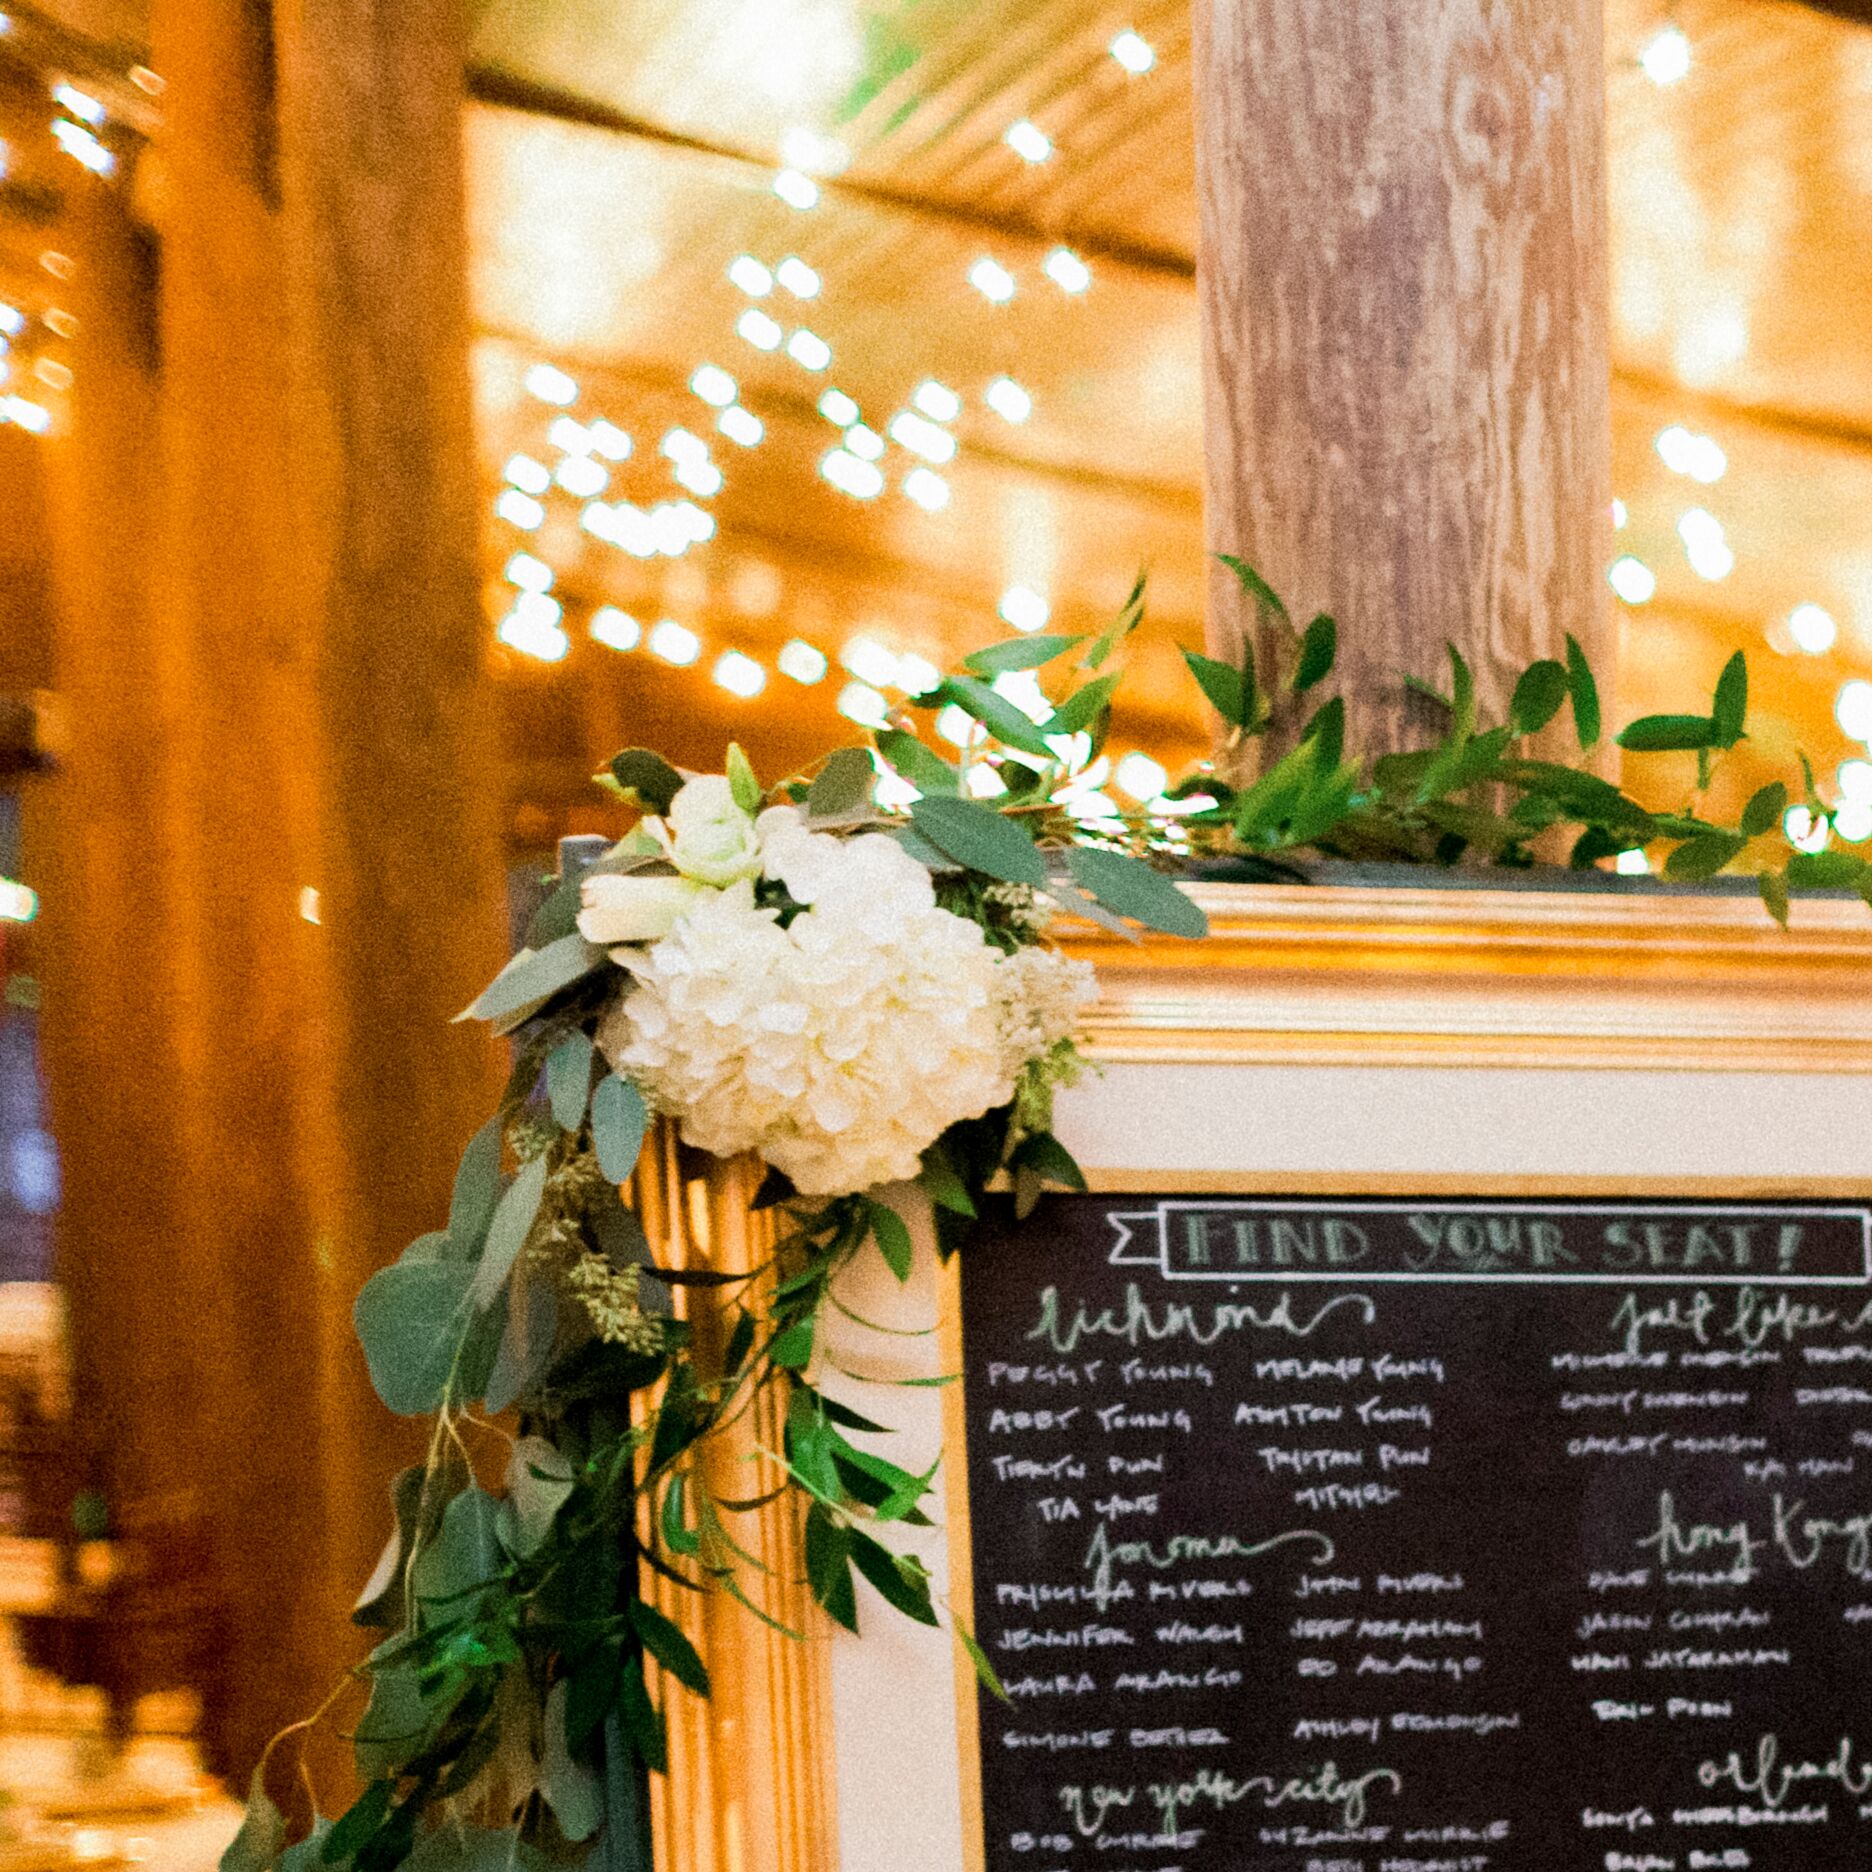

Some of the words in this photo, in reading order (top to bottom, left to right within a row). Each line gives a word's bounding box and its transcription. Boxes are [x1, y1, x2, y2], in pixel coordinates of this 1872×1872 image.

[1184, 1213, 1369, 1265] FIND
[1402, 1213, 1577, 1271] YOUR
[1603, 1222, 1803, 1271] SEAT!
[1023, 1283, 1375, 1354] richmond
[988, 1359, 1103, 1386] PEGGY
[1120, 1357, 1214, 1387] YOUNG
[1371, 1353, 1444, 1383] YOUNG
[989, 1406, 1080, 1434] ABBY
[1095, 1402, 1192, 1433] YOUNG
[1356, 1395, 1433, 1428] YOUNG
[997, 1623, 1135, 1651] JENNIFER
[1356, 1653, 1482, 1681] ARANGO
[1003, 1672, 1096, 1698] LAURA
[1114, 1667, 1242, 1692] ARANGO
[1002, 1729, 1114, 1751] SIMONE
[1060, 1784, 1135, 1836] new
[1010, 1831, 1074, 1852] BOB
